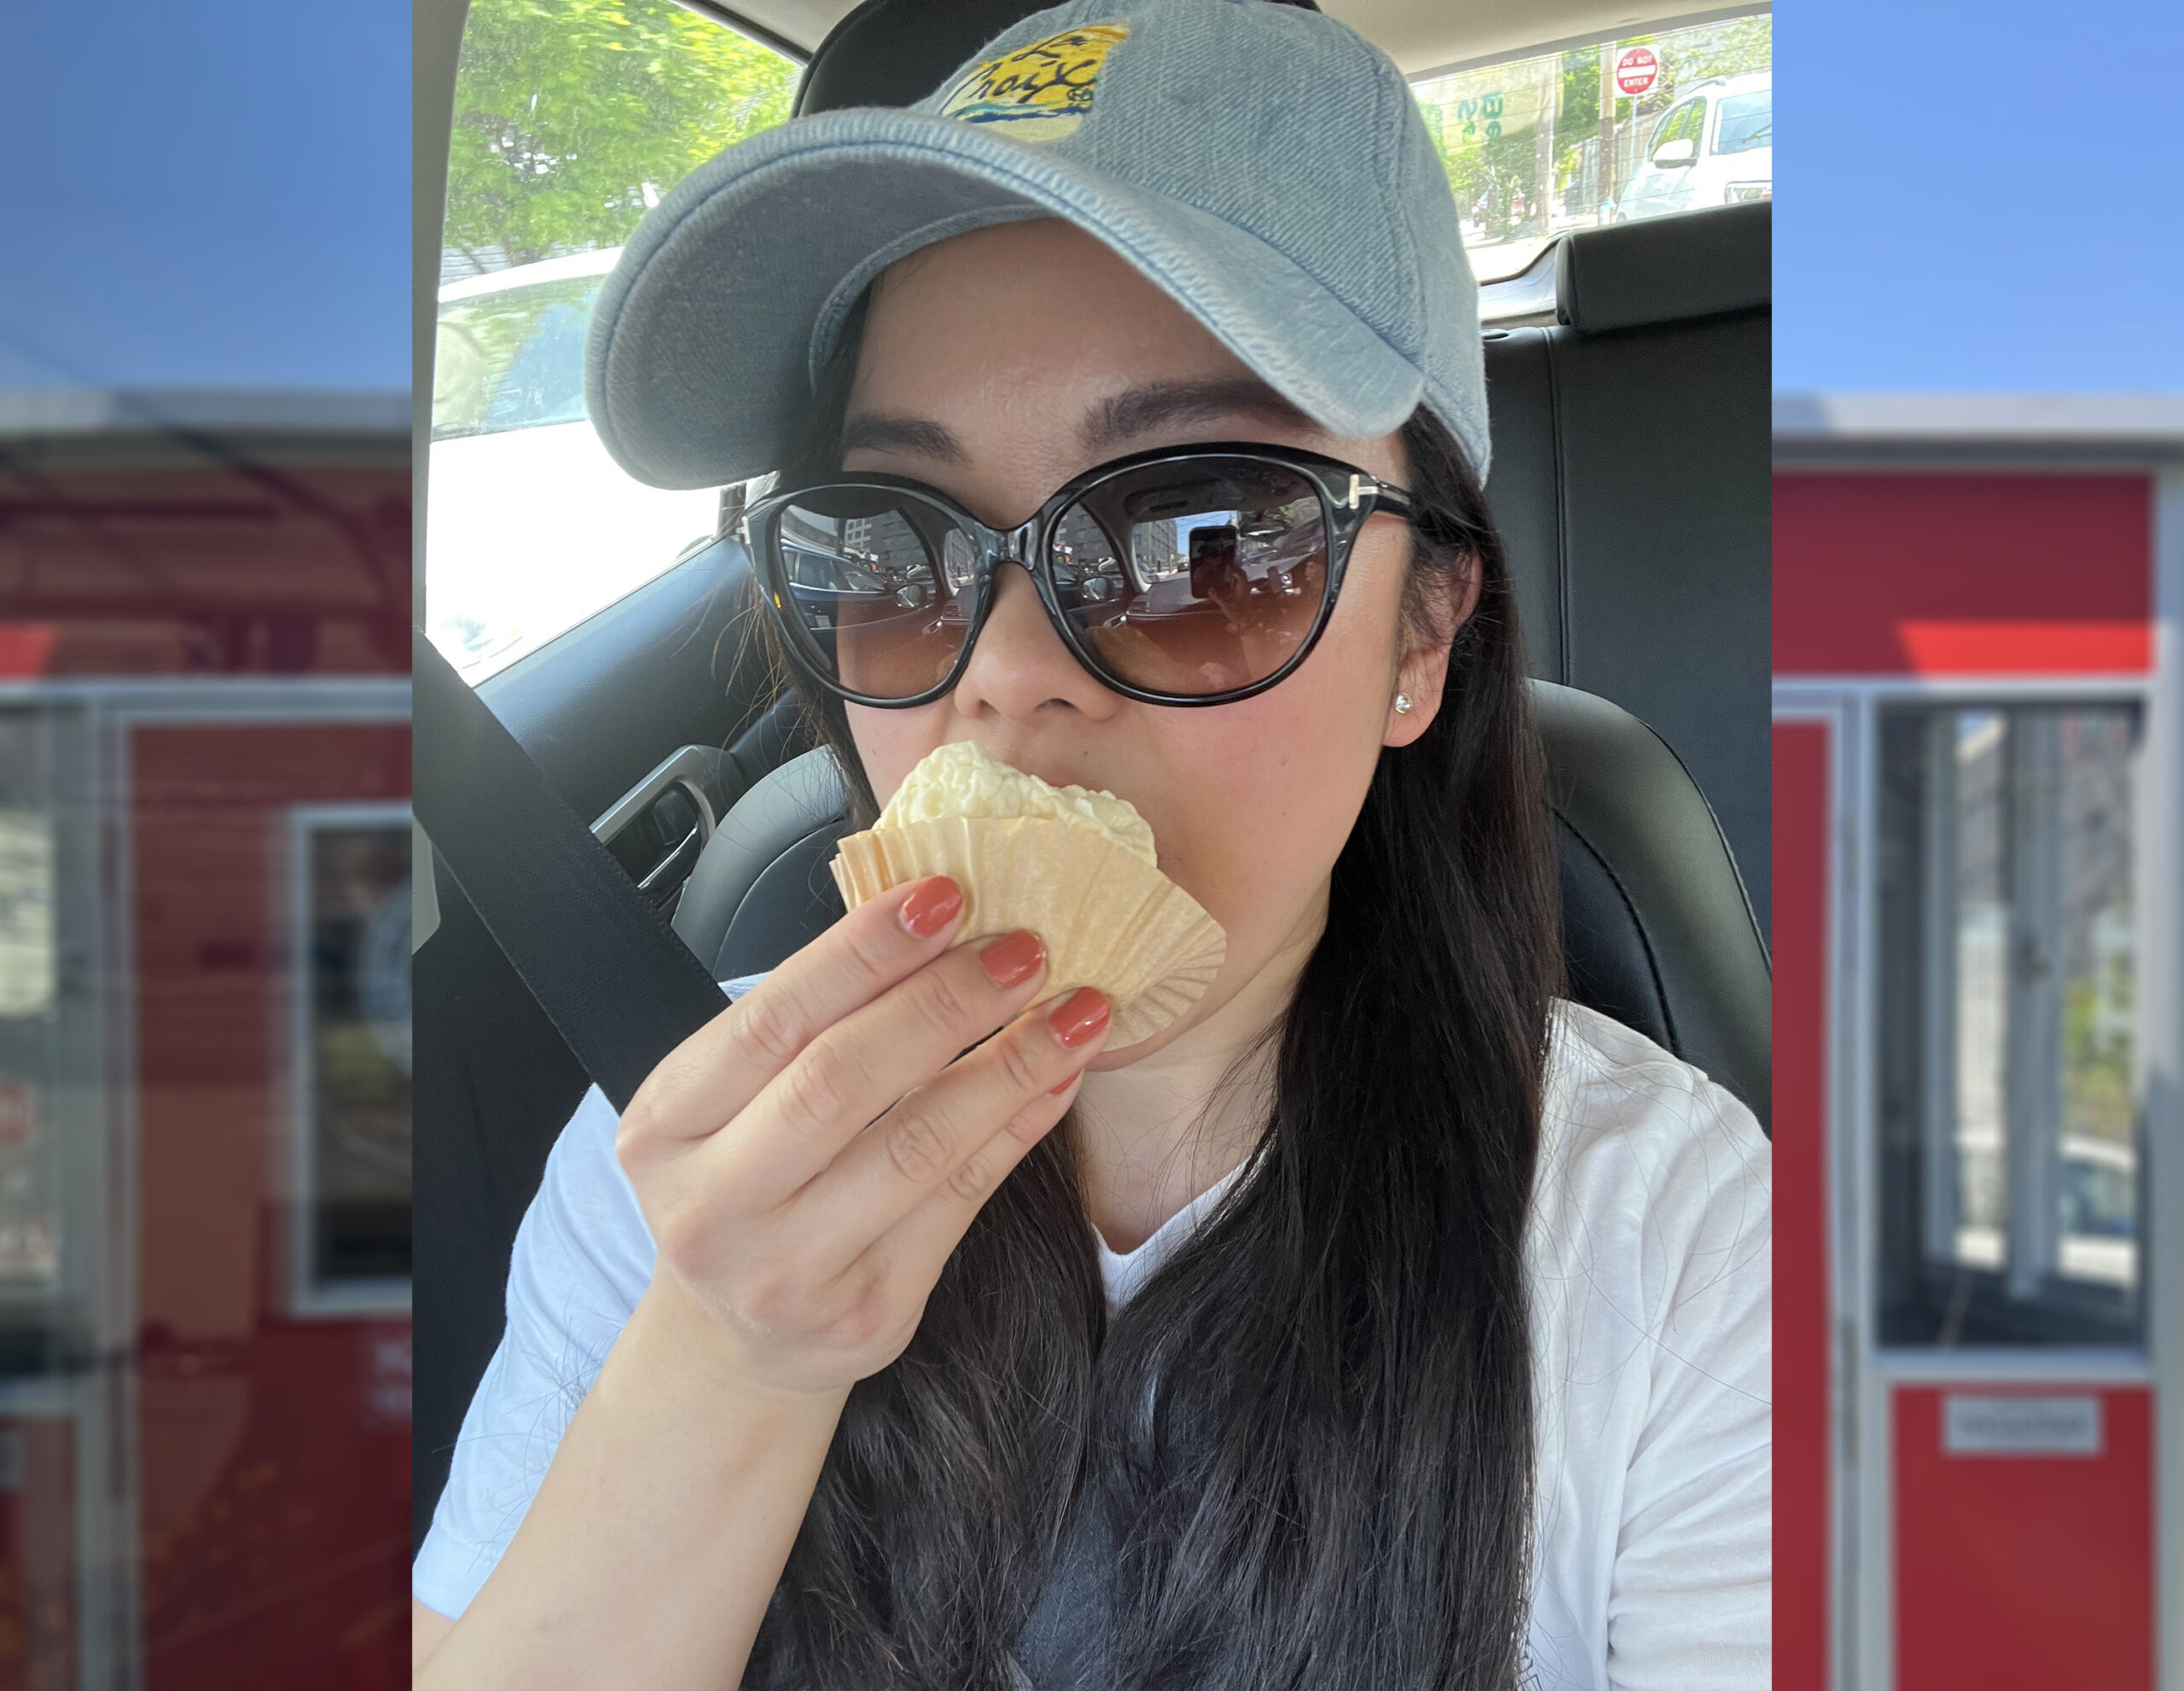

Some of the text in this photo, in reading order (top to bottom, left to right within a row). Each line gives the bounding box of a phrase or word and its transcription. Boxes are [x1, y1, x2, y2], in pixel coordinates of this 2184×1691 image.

[1623, 55, 1652, 67] DO NOT
[1623, 78, 1648, 88] ENTER
